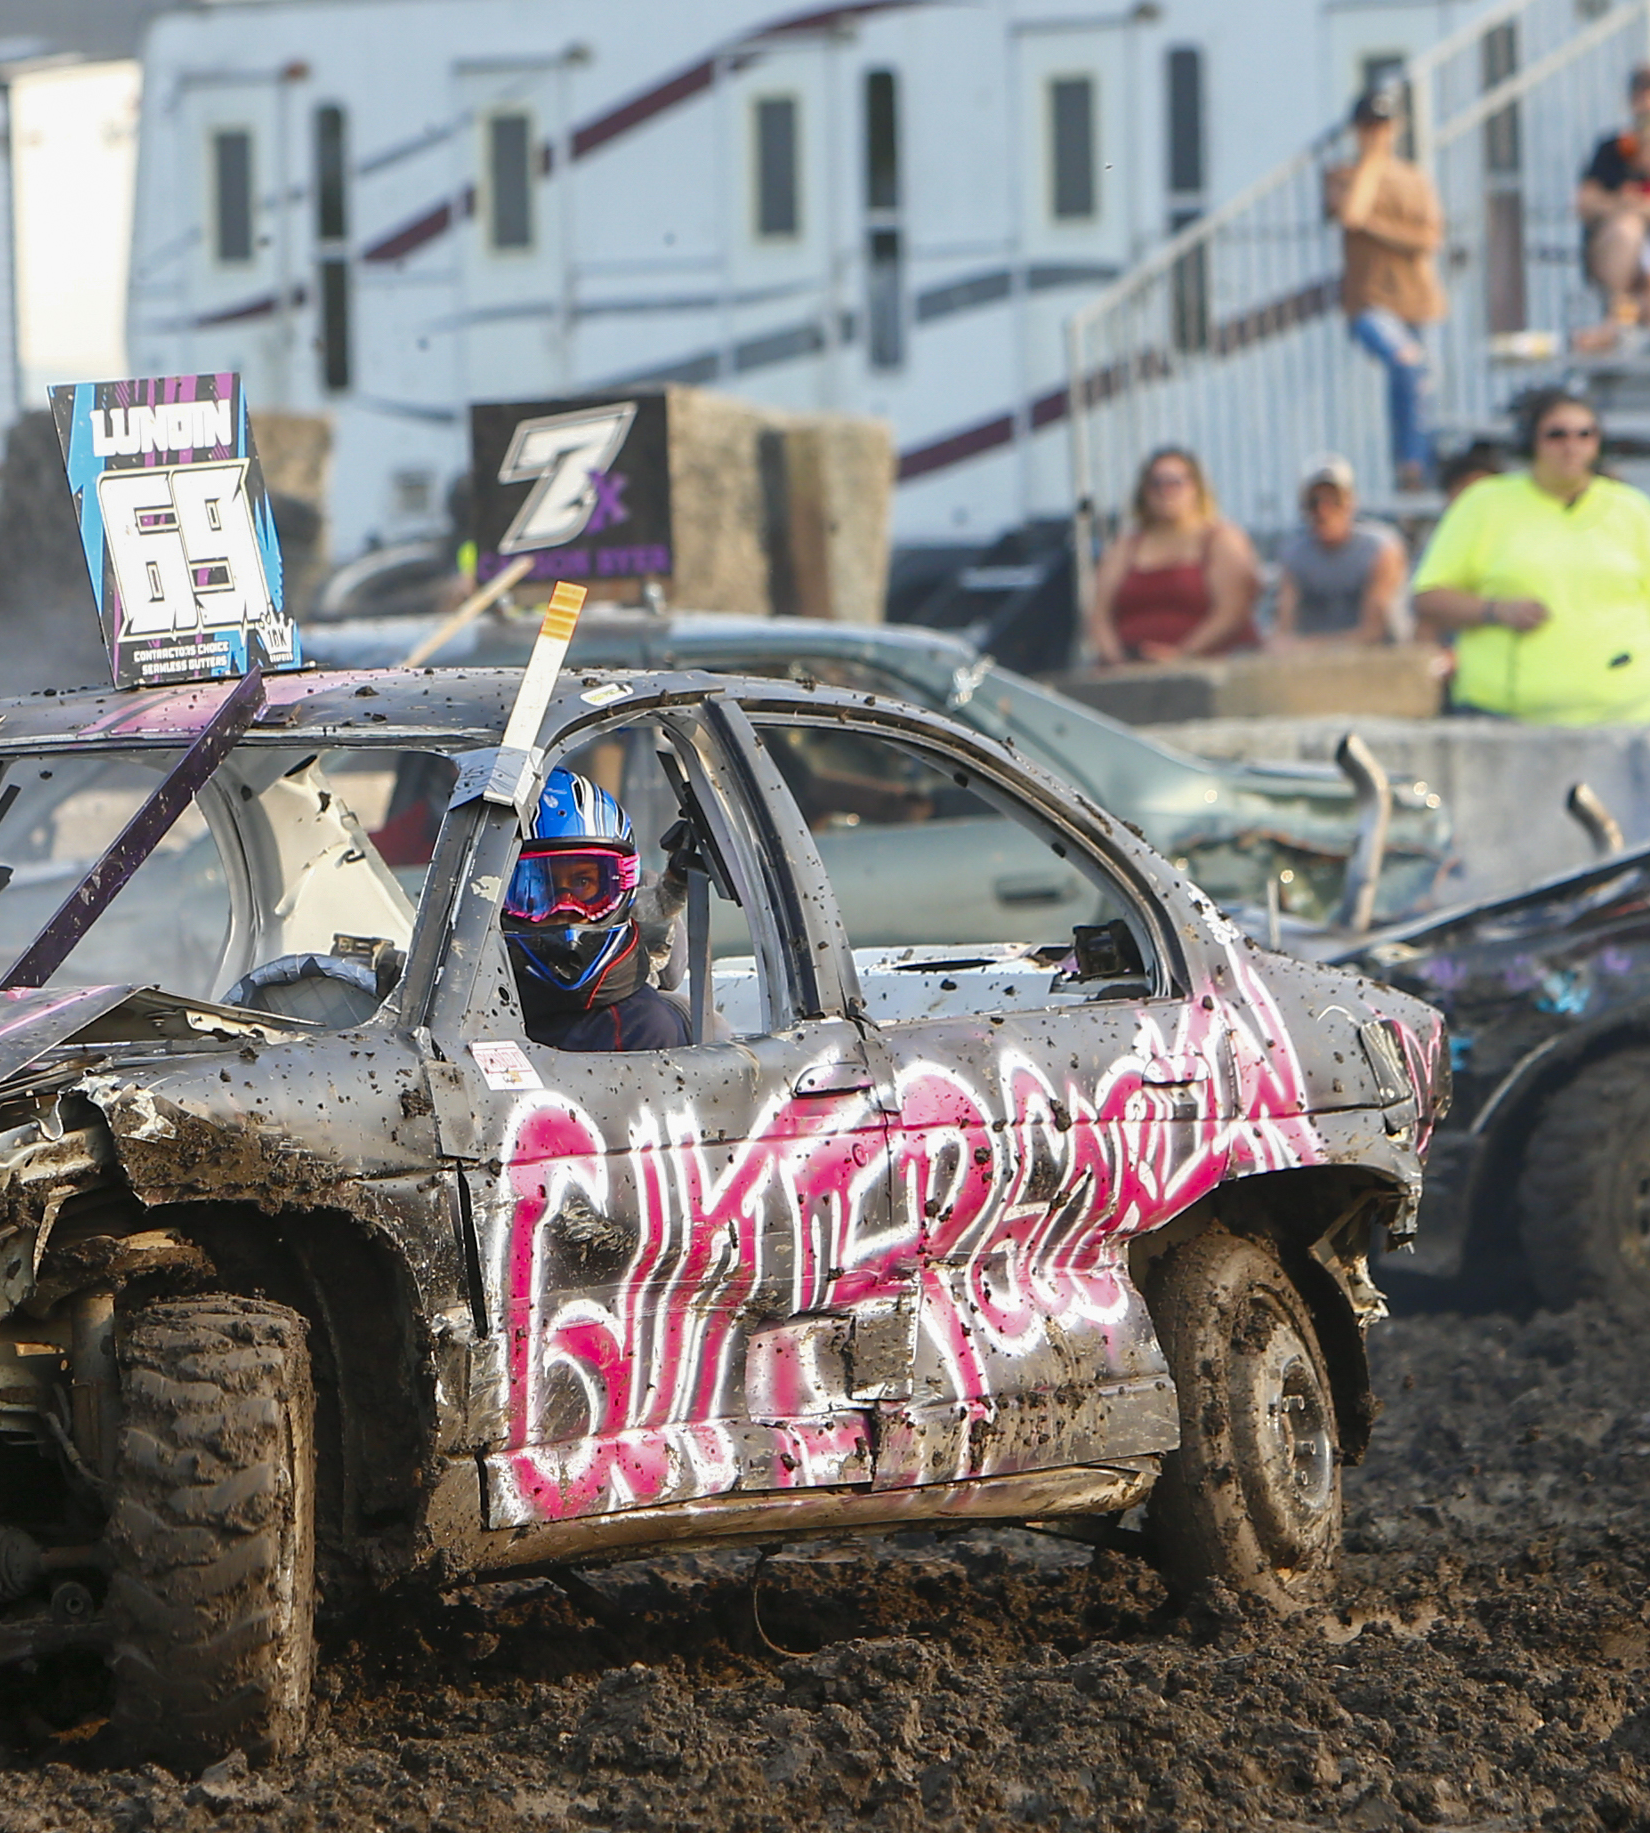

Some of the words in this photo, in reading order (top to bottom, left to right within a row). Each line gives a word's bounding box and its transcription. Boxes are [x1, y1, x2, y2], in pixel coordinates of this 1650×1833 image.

[90, 399, 232, 457] LUNDIN
[97, 460, 271, 641] 69
[133, 645, 196, 663] CONTRACTORS
[197, 641, 229, 655] CHOICE
[142, 660, 187, 676] SEAMLESS
[188, 655, 228, 670] GUTTERS
